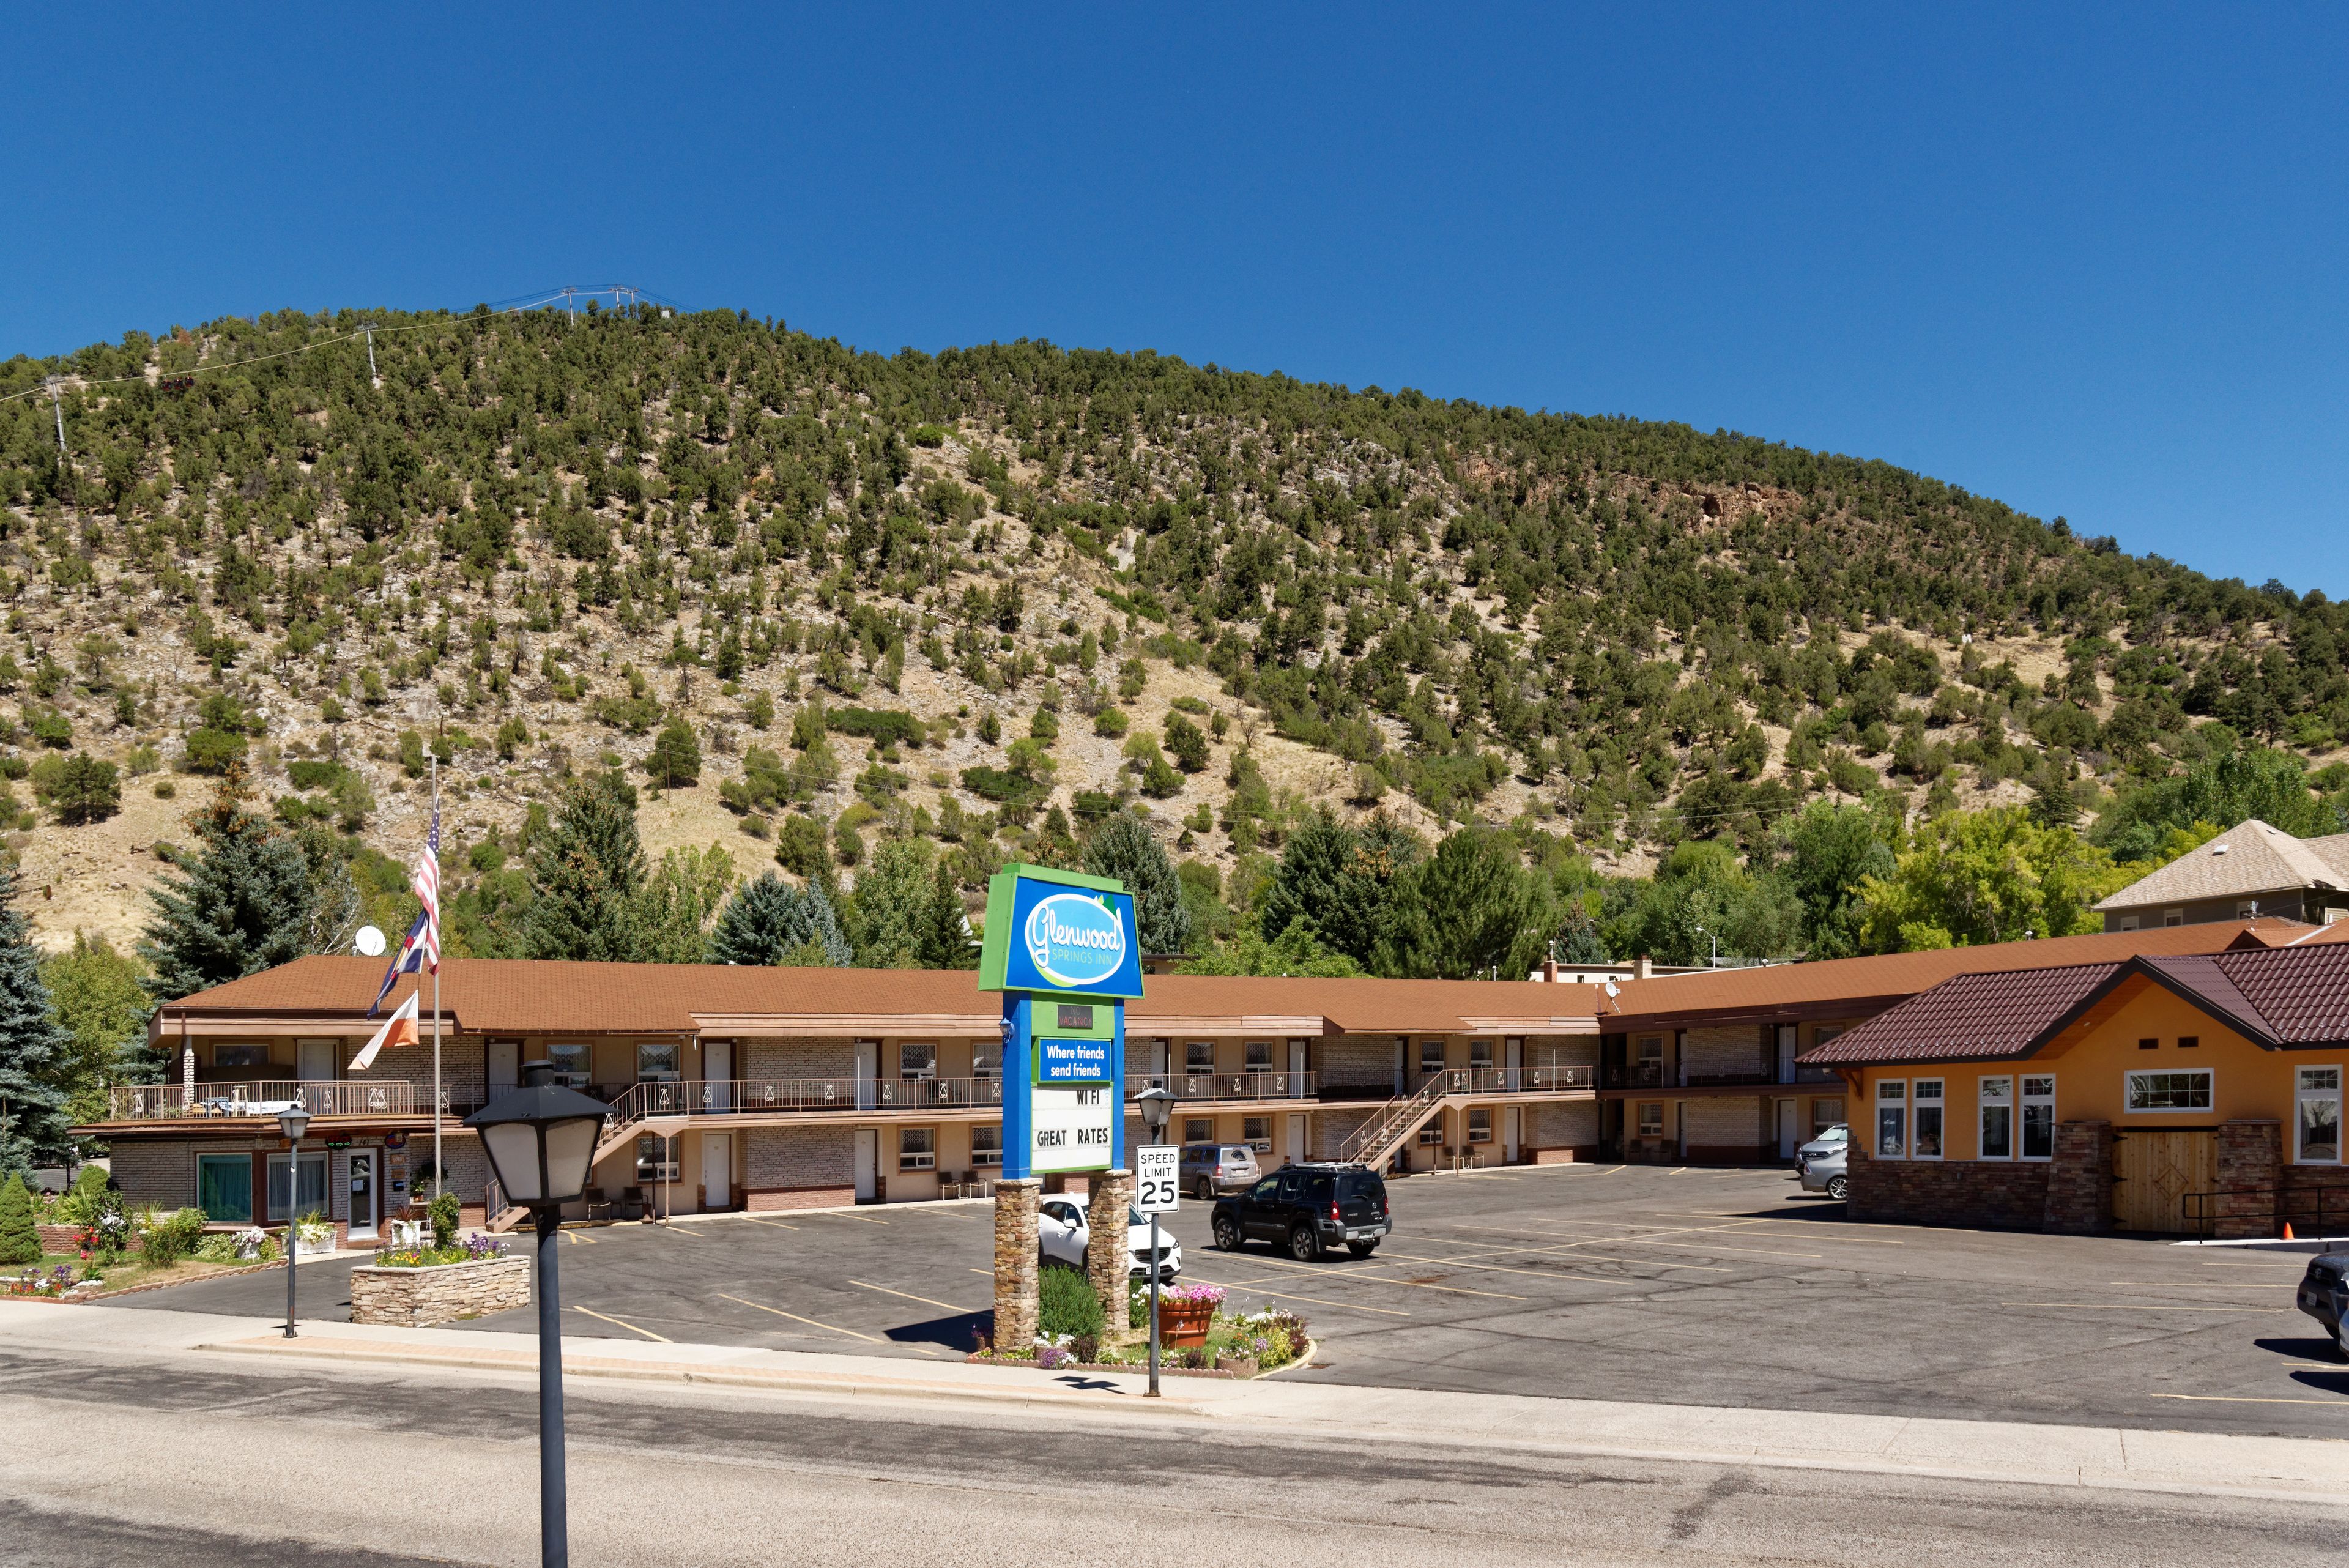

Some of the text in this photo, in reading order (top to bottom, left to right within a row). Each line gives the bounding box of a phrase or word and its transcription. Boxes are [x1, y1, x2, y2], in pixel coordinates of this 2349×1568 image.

[1032, 905, 1121, 968] Glenwood
[1052, 948, 1113, 966] SPRINGS INN
[1071, 1006, 1081, 1016] NO
[1059, 1016, 1092, 1026] VACANCY
[1047, 1045, 1105, 1060] Where friends
[1050, 1063, 1101, 1077] send friends
[1037, 1128, 1108, 1146] GREAT RATES
[1141, 1154, 1175, 1164] SPEED
[1145, 1167, 1171, 1177] LIMIT
[1141, 1181, 1174, 1205] 25
